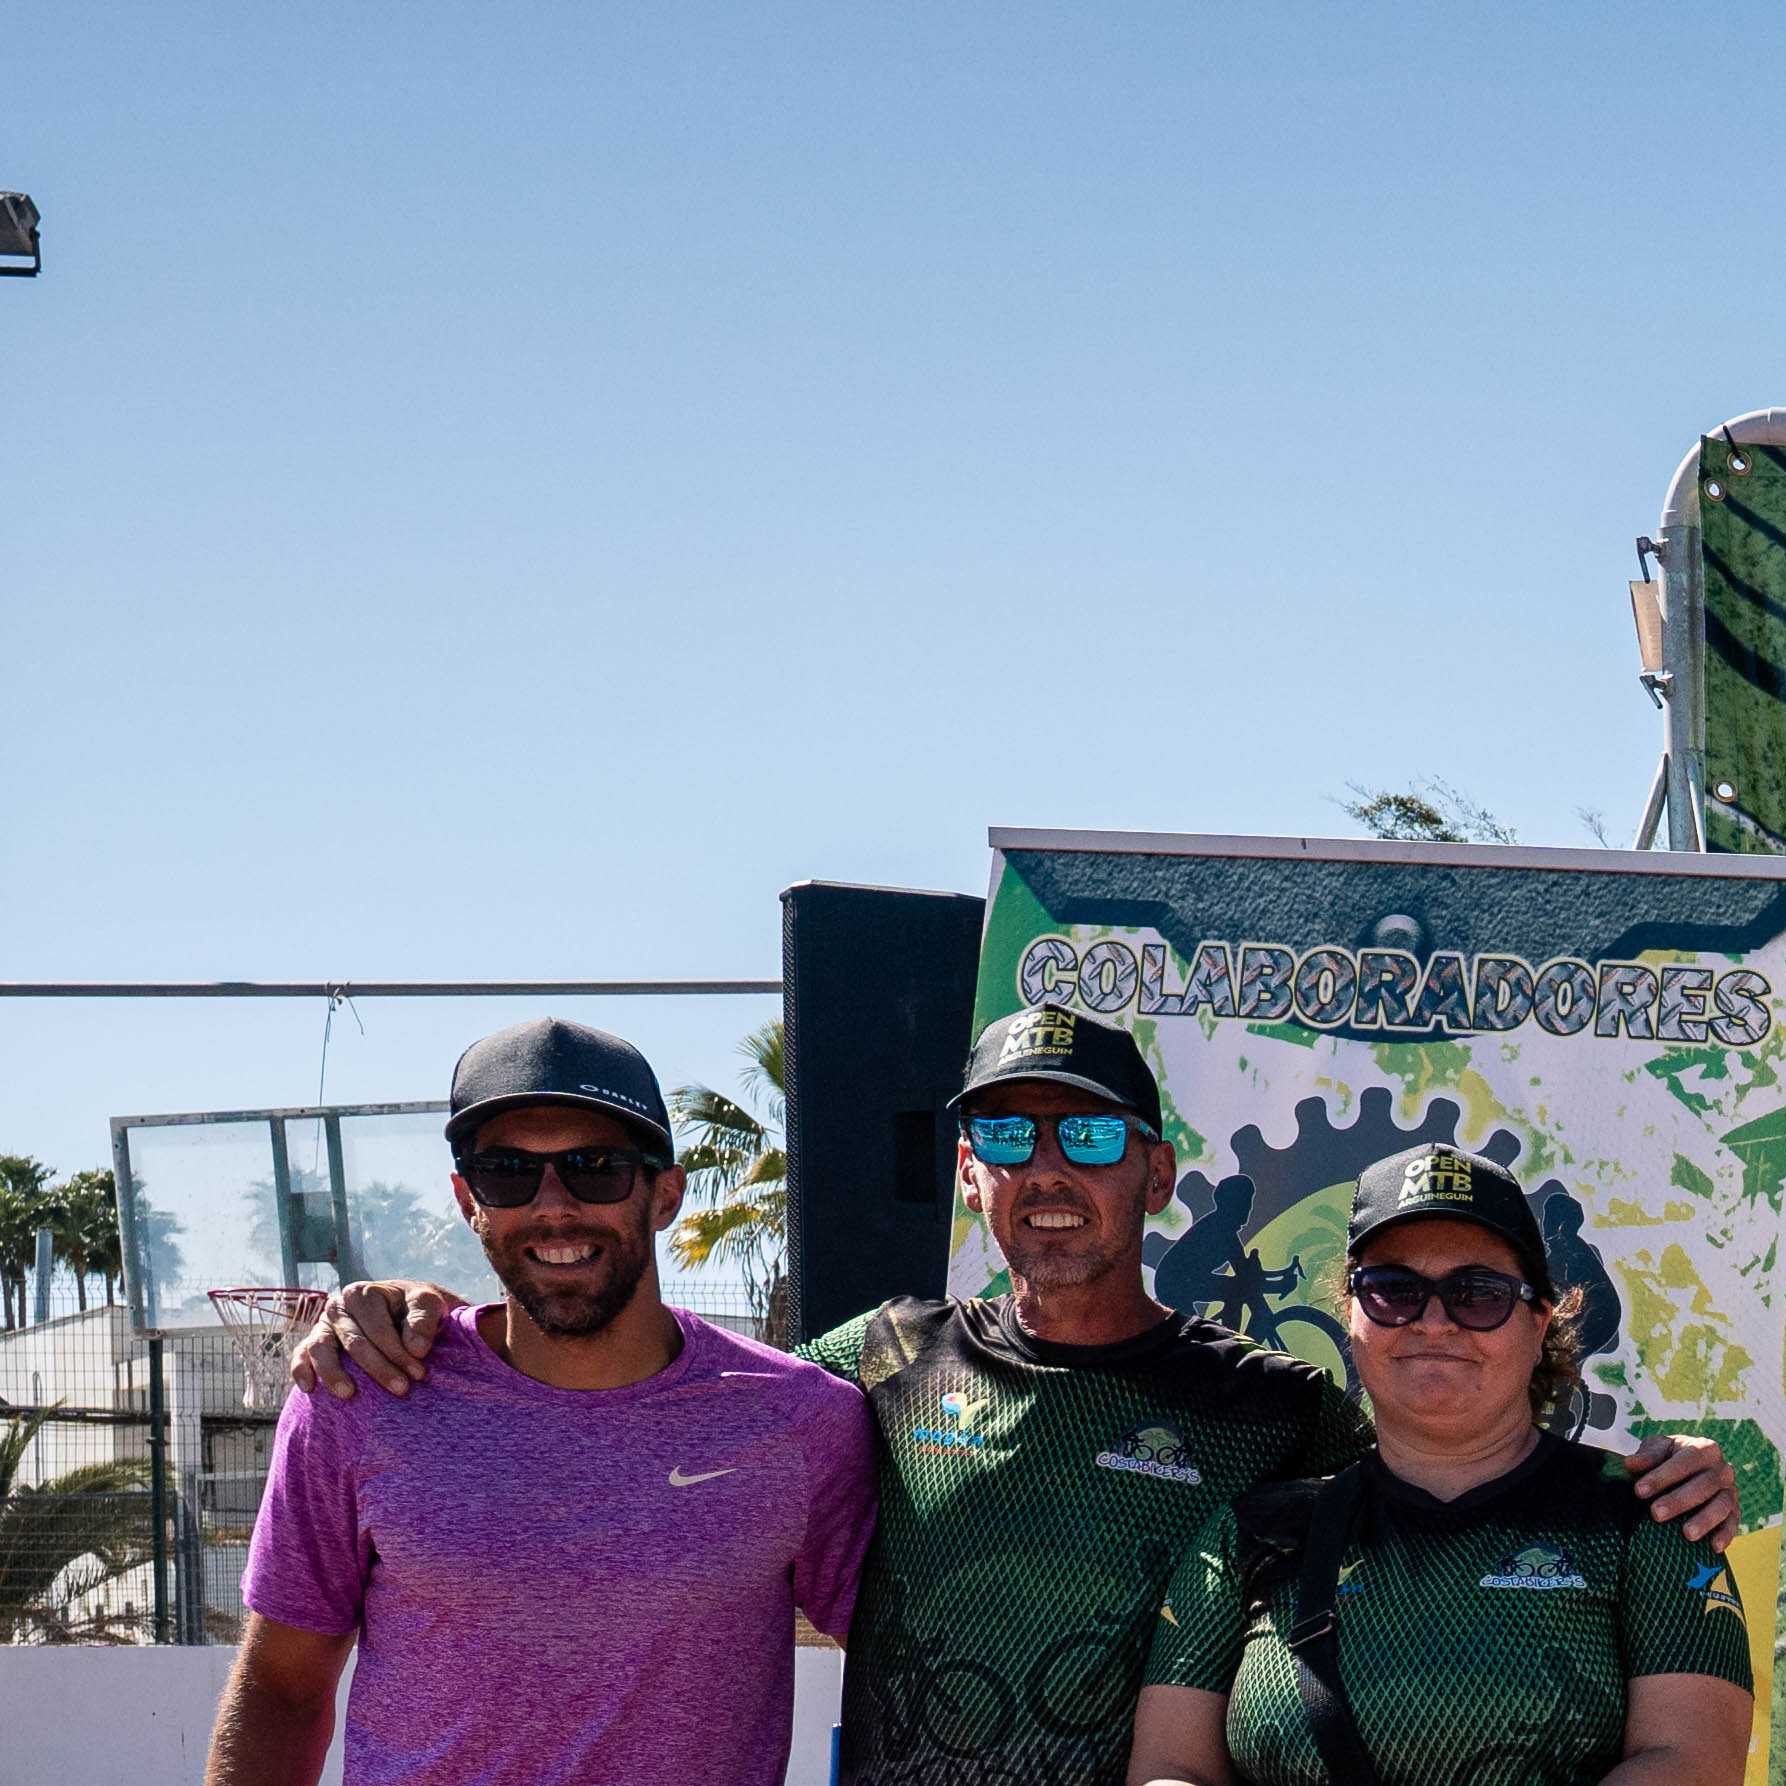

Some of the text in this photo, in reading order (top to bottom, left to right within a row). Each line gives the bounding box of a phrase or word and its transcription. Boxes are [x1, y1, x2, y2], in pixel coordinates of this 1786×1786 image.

[1017, 935, 1773, 1046] COLABORADORES
[1008, 1011, 1075, 1035] OPEN
[1000, 1027, 1073, 1058] MTB
[1405, 1154, 1472, 1177] OPEN
[1398, 1171, 1472, 1200] MTB
